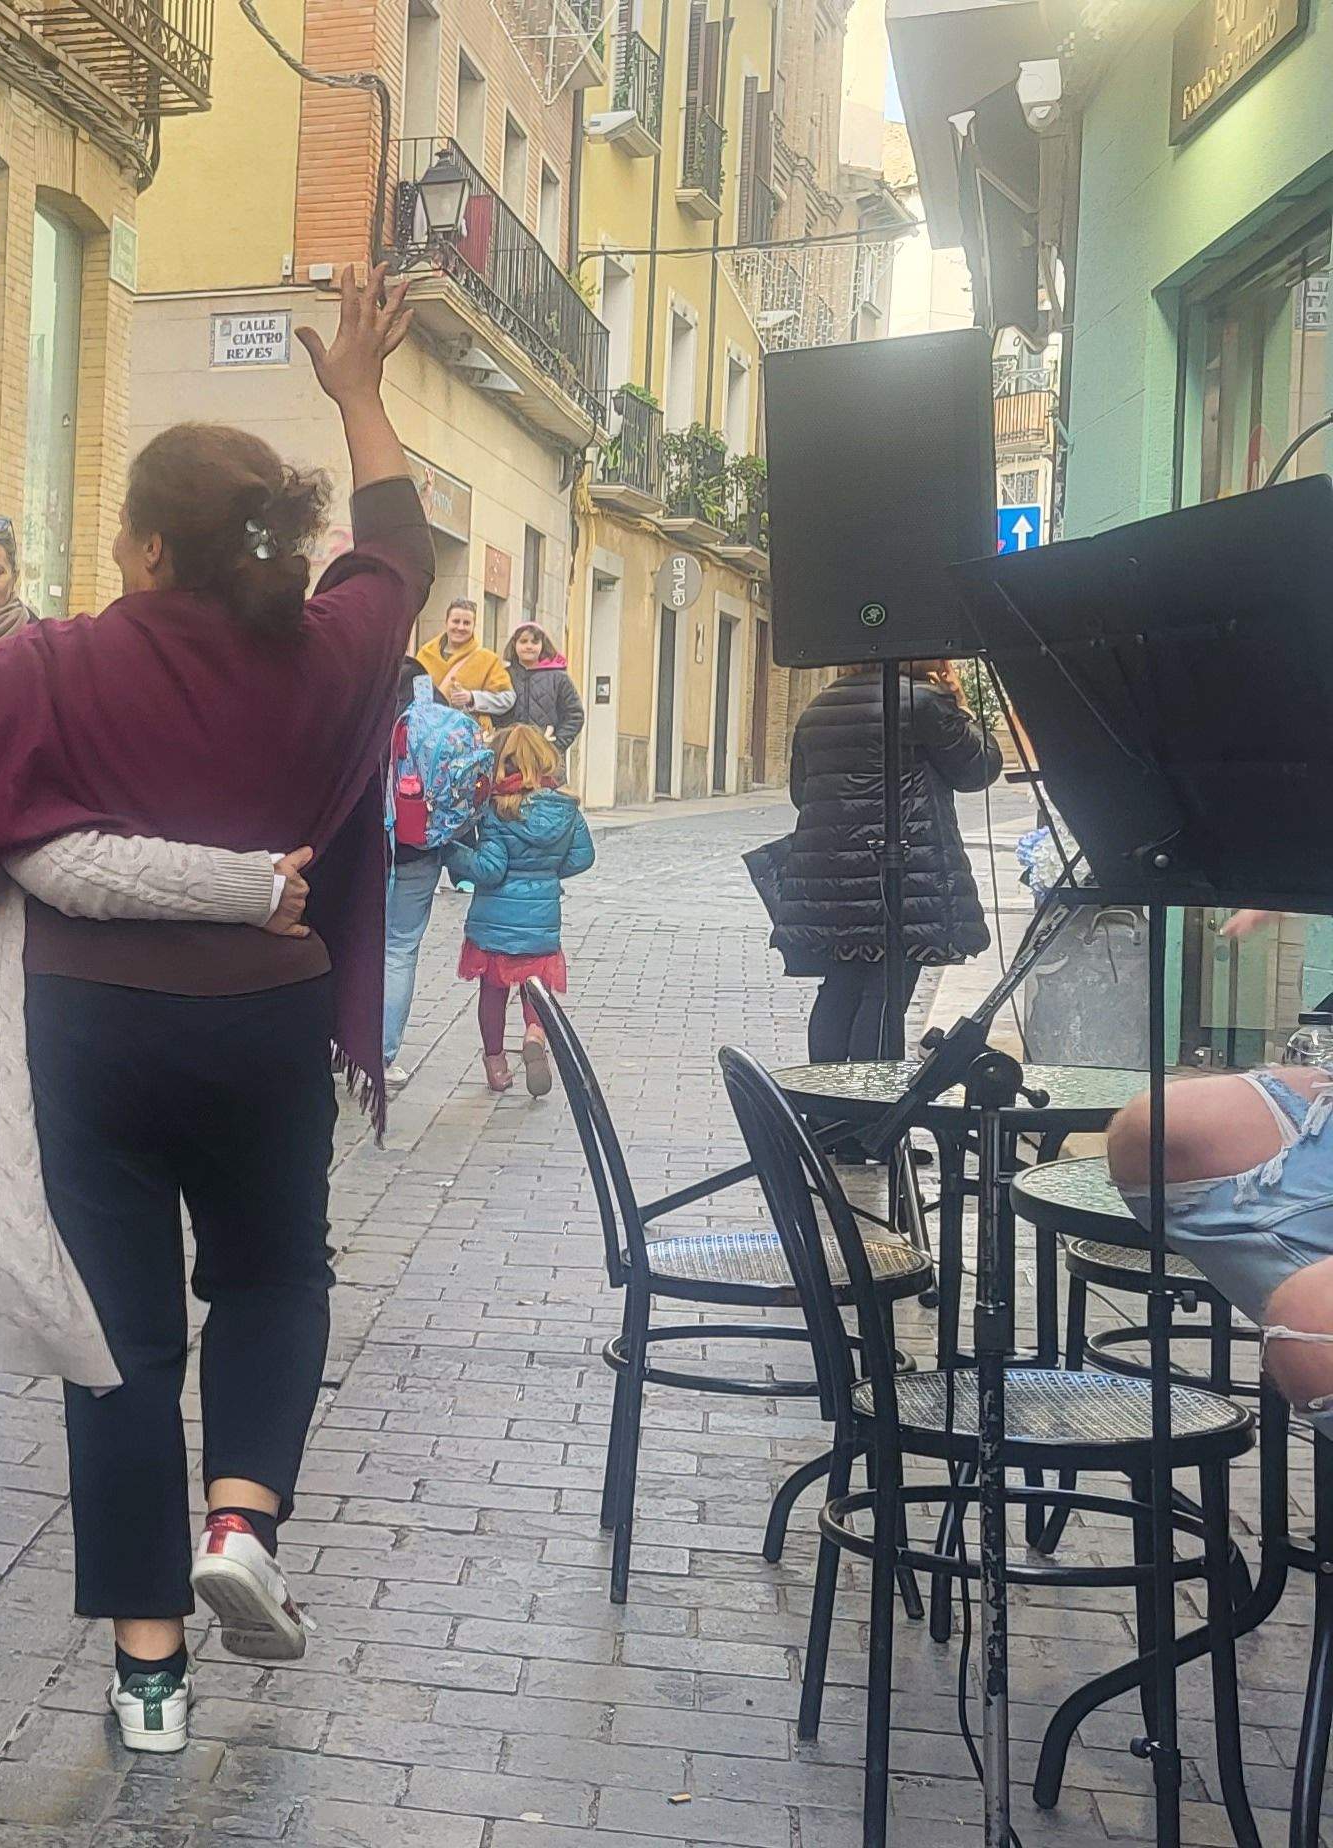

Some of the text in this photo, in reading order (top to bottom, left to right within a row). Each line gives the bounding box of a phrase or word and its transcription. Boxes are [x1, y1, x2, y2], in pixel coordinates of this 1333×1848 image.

[239, 319, 276, 332] CALLE
[233, 332, 283, 346] CUATRO
[226, 347, 273, 360] REYES
